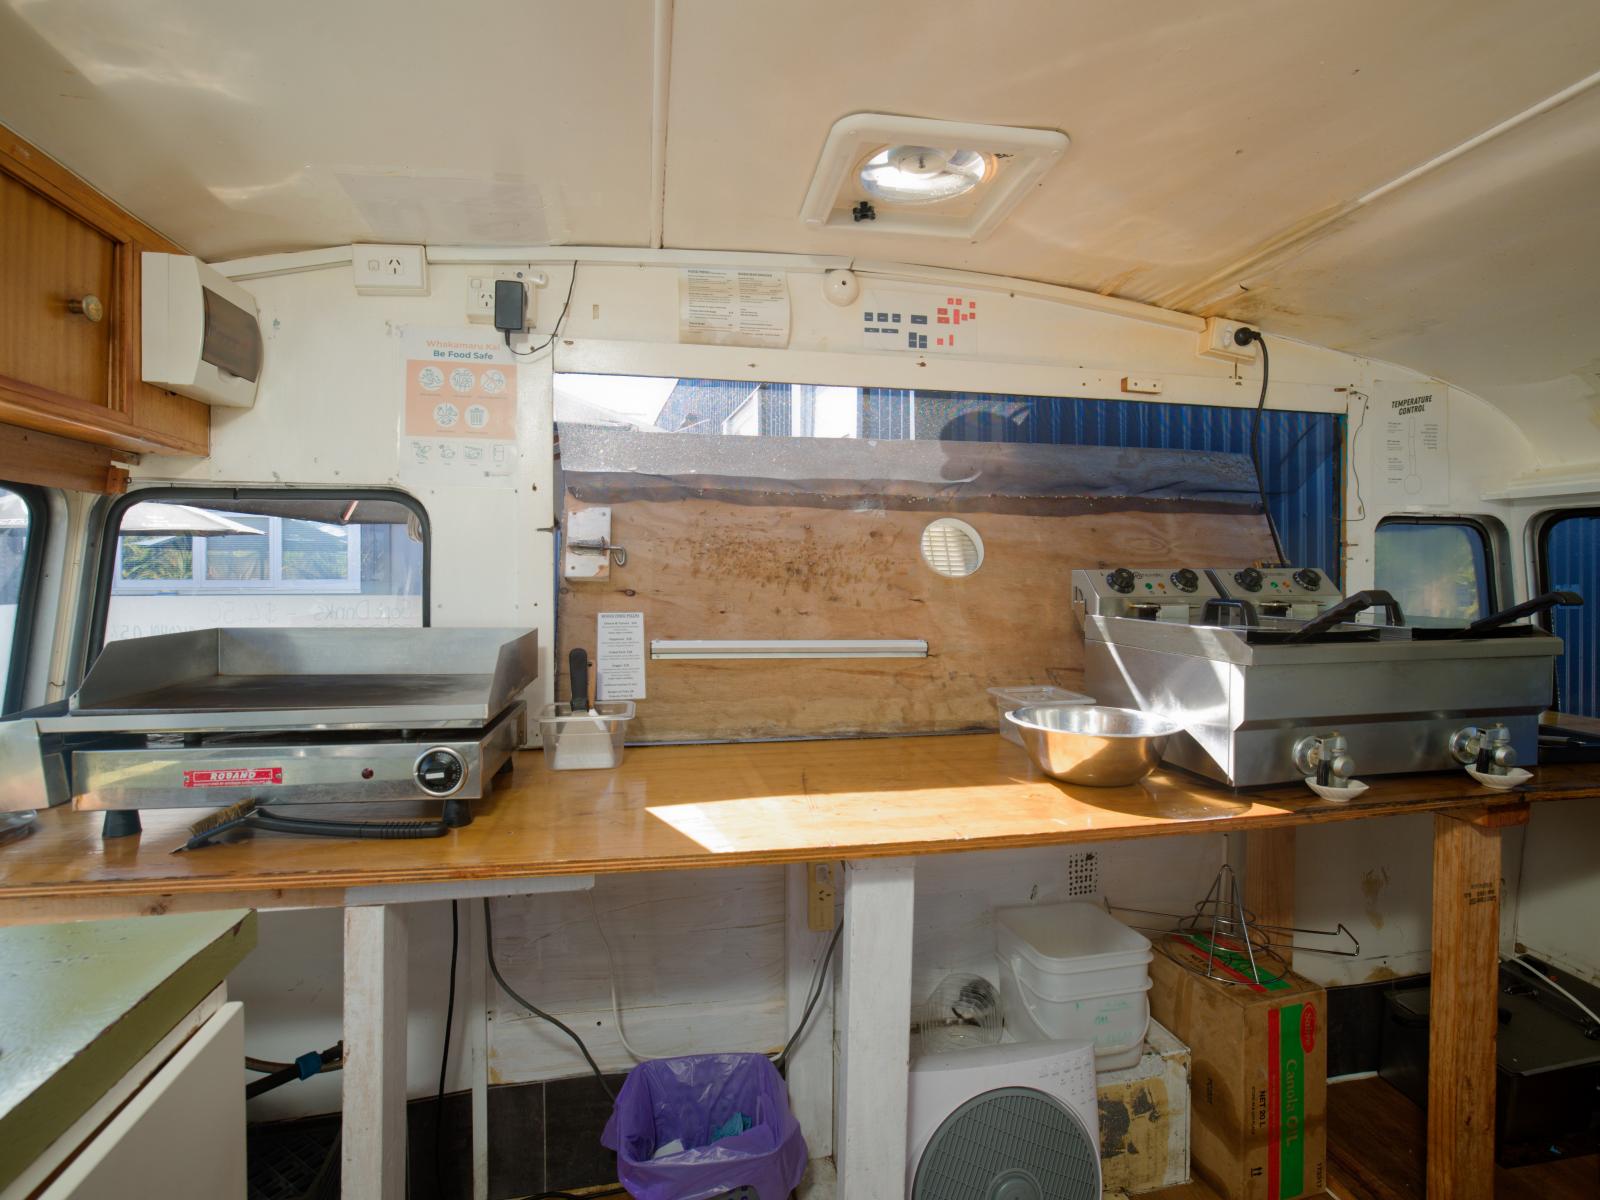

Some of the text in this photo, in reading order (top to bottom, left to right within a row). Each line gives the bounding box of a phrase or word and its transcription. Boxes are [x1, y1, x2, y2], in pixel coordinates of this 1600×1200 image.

[448, 350, 471, 359] Food
[473, 352, 494, 360] Safe
[1392, 395, 1432, 408] TEMPERATURE
[1399, 404, 1425, 415] CONTROL
[210, 771, 257, 781] ROBAND
[1285, 1059, 1298, 1147] Canola OIL
[1259, 1109, 1266, 1120] 20
